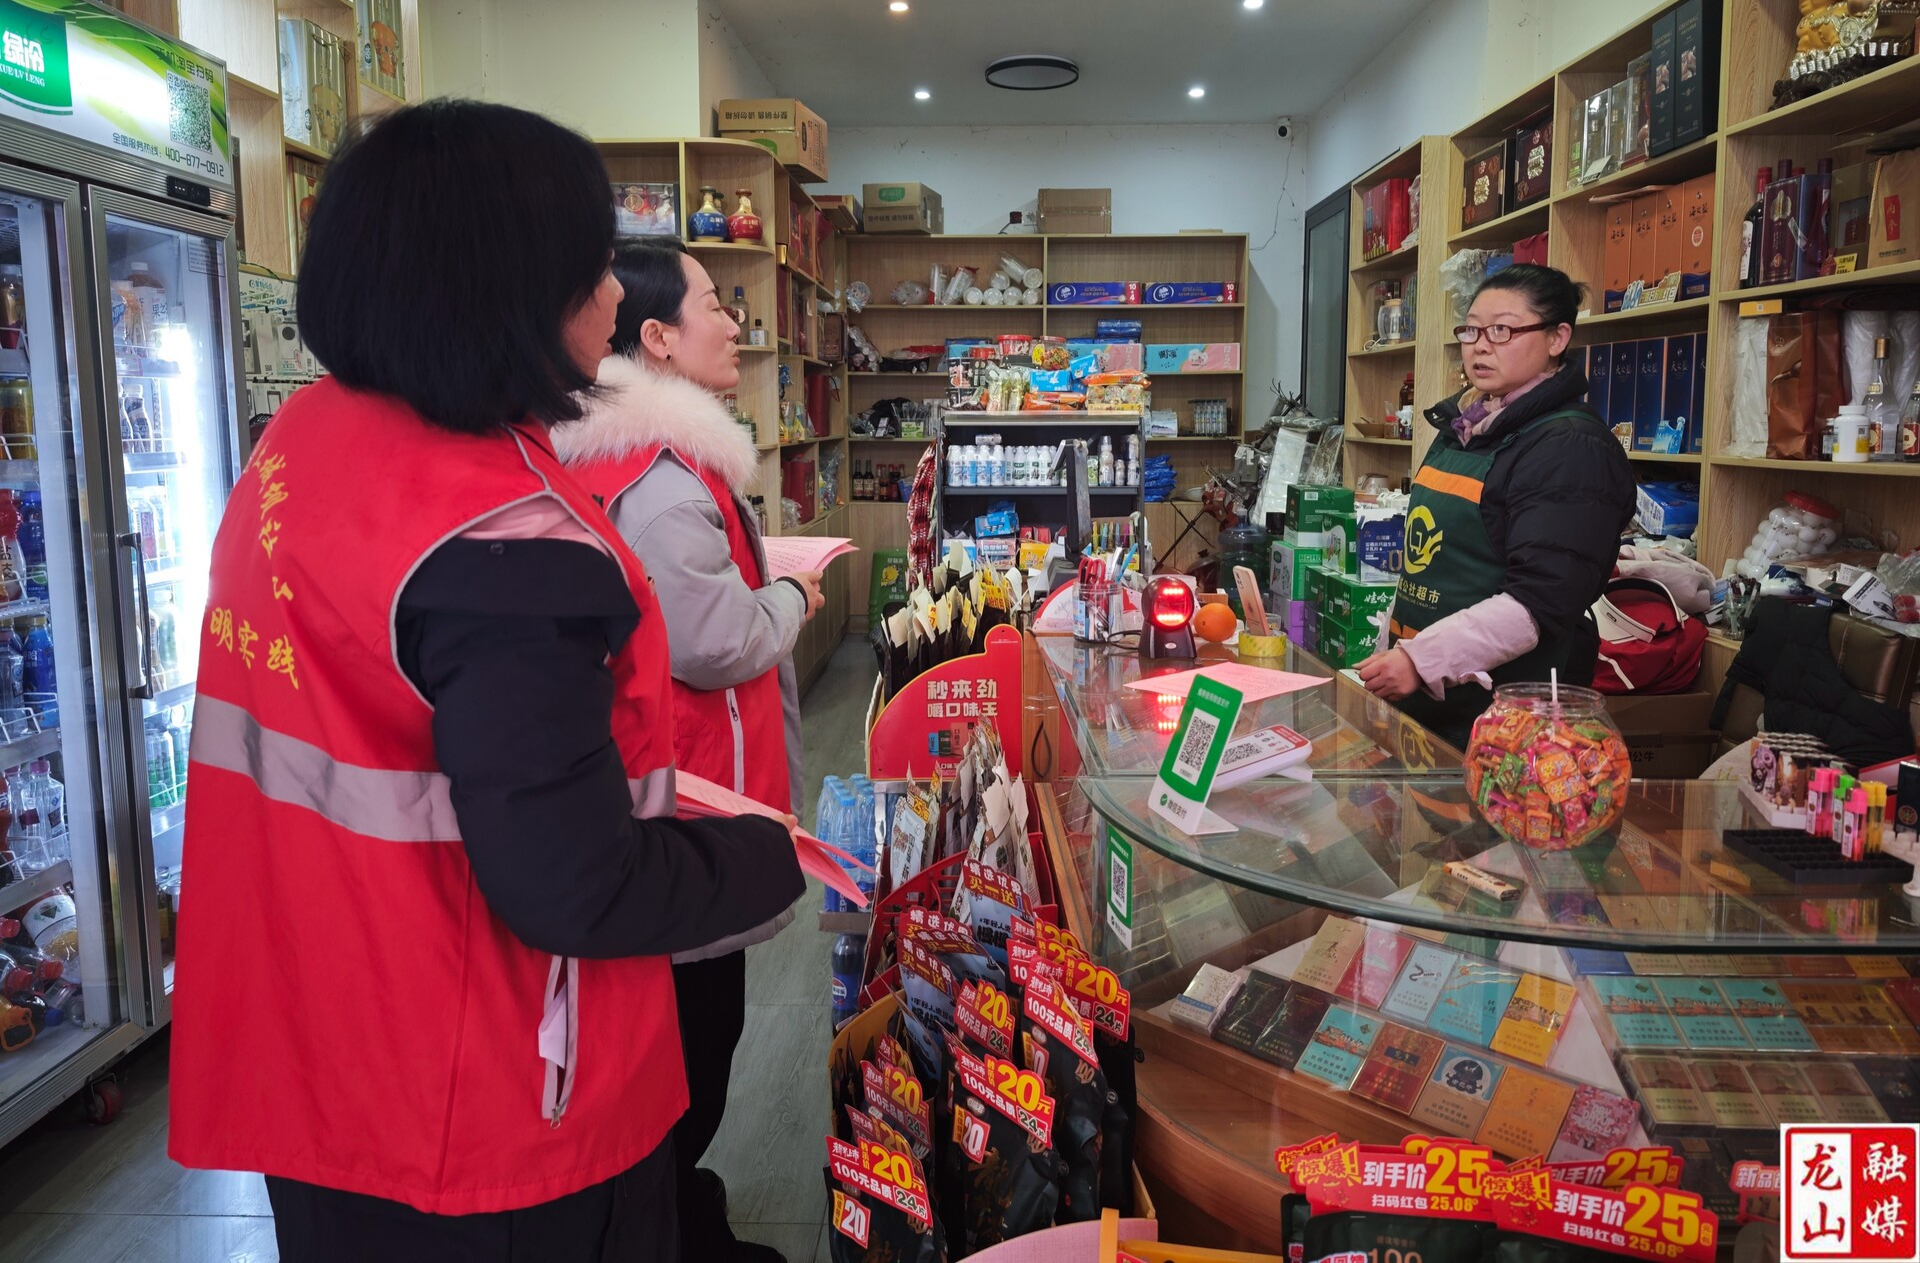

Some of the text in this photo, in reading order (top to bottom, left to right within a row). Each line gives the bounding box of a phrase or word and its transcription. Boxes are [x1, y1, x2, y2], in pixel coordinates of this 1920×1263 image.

[3, 30, 45, 73] 绿冷
[25, 72, 46, 87] LENG
[165, 147, 224, 177] 400-877-0912
[927, 678, 997, 700] 秒来劲
[927, 702, 998, 718] 嚼口味王
[1363, 1161, 1427, 1189] 到手价
[1426, 1147, 1490, 1196] 25
[1605, 1151, 1668, 1186] 25
[1372, 1194, 1428, 1209] 扫码红包
[1554, 1189, 1627, 1227] 到手价
[1623, 1187, 1700, 1246] 25
[1563, 1221, 1626, 1246] 扫码红包
